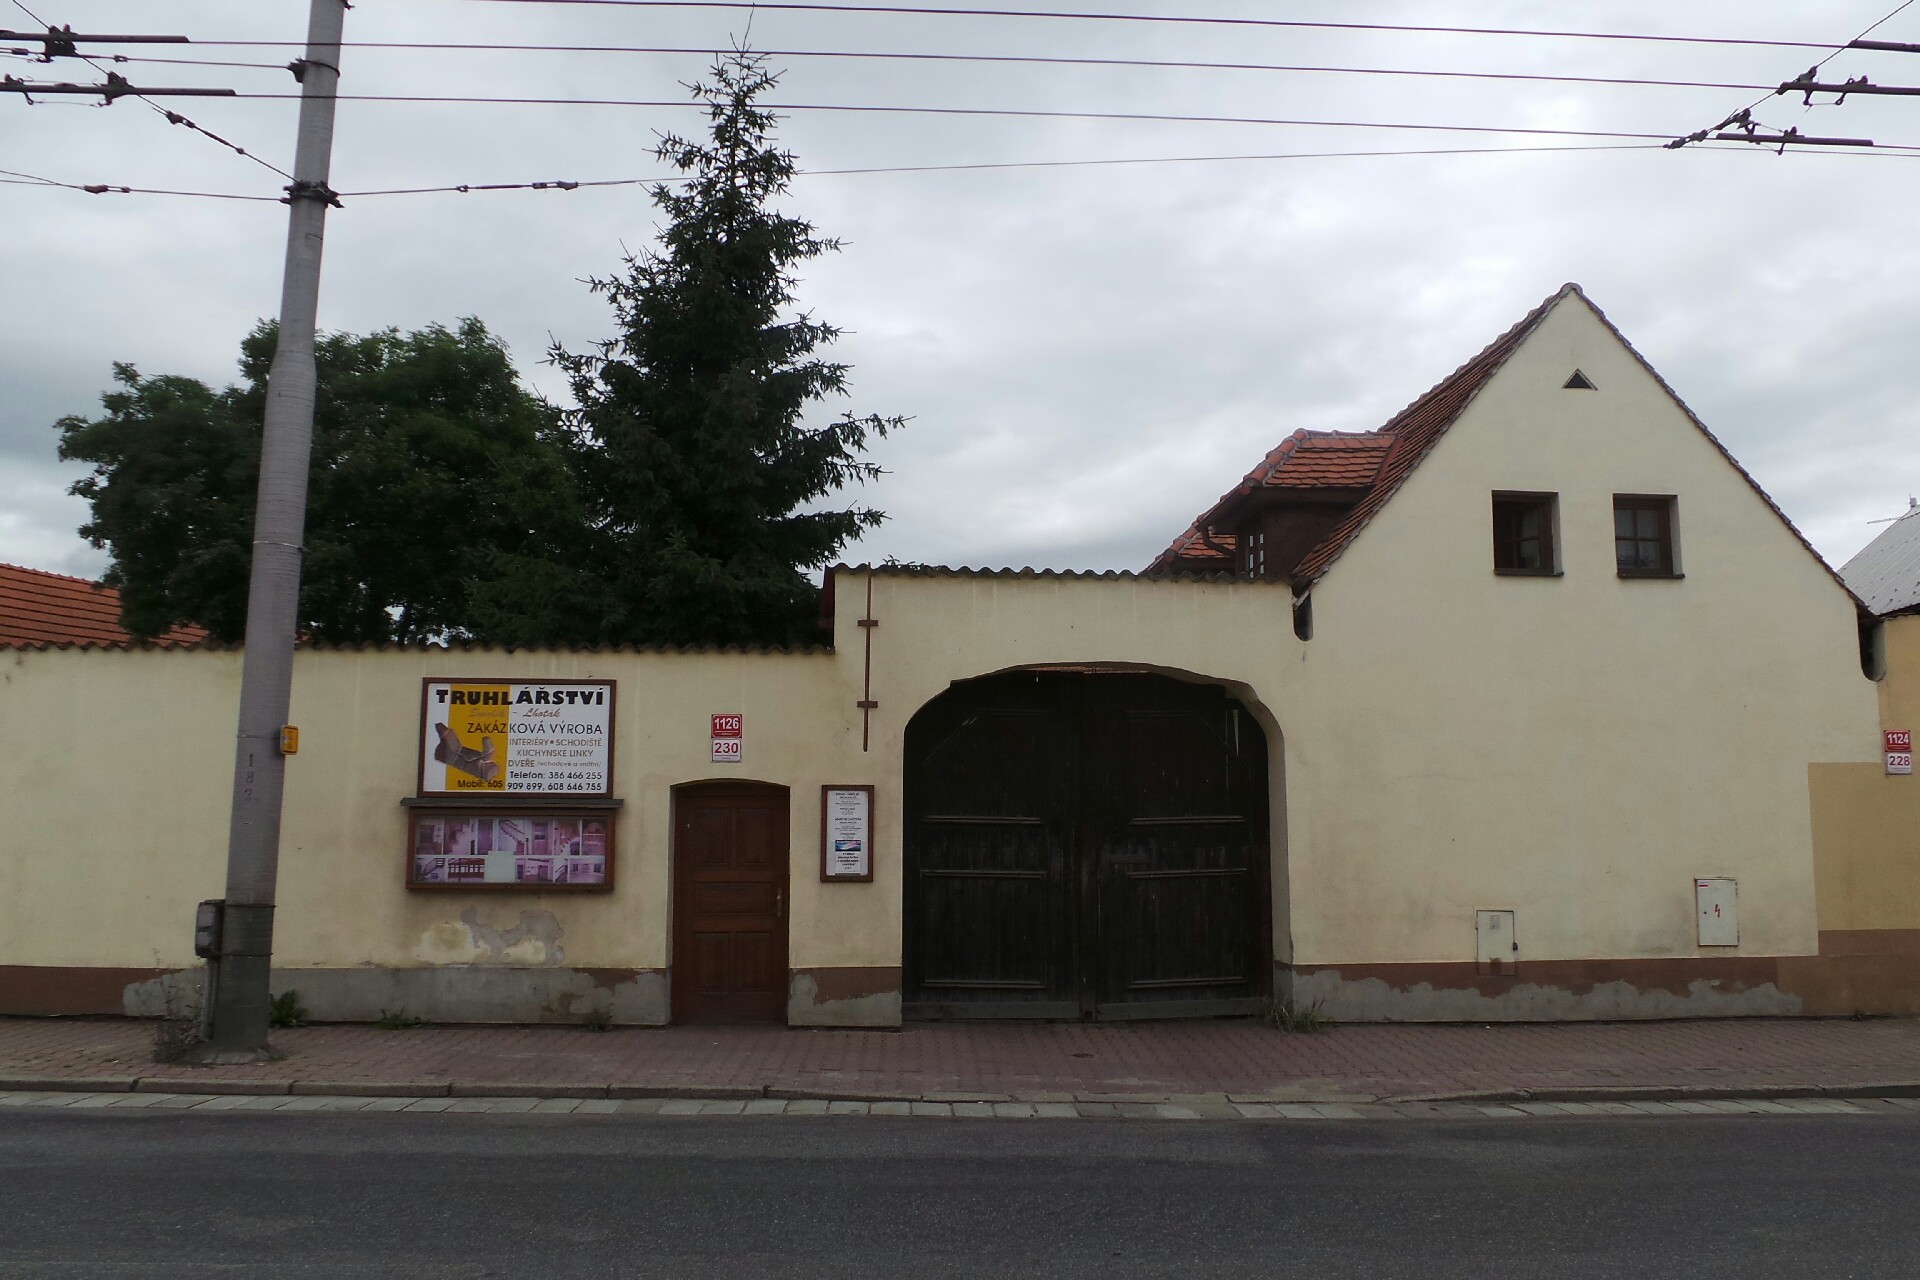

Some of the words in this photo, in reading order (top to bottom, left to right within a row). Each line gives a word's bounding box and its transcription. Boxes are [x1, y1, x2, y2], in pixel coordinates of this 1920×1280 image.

[436, 687, 604, 705] TRUHLÁŘSTVÍ
[522, 708, 561, 718] Lhoták
[467, 720, 546, 734] ZAKÁZKOVÁ
[549, 720, 603, 735] VÝROBA
[714, 717, 739, 730] 1126
[508, 737, 548, 746] INTERIÉRY
[555, 737, 602, 747] SCHODIŠTĚ
[1887, 733, 1909, 744] 1124
[714, 742, 738, 754] 230
[508, 758, 535, 767] DVEŘE
[1889, 756, 1910, 766] 228
[509, 771, 546, 779] Telefon:
[548, 772, 565, 780] 386
[567, 772, 584, 780] 466
[586, 772, 602, 780] 255
[457, 780, 485, 788] Mobil:
[487, 780, 503, 788] 605
[547, 783, 564, 791] 608
[566, 783, 584, 791] 646
[586, 783, 602, 791] 755
